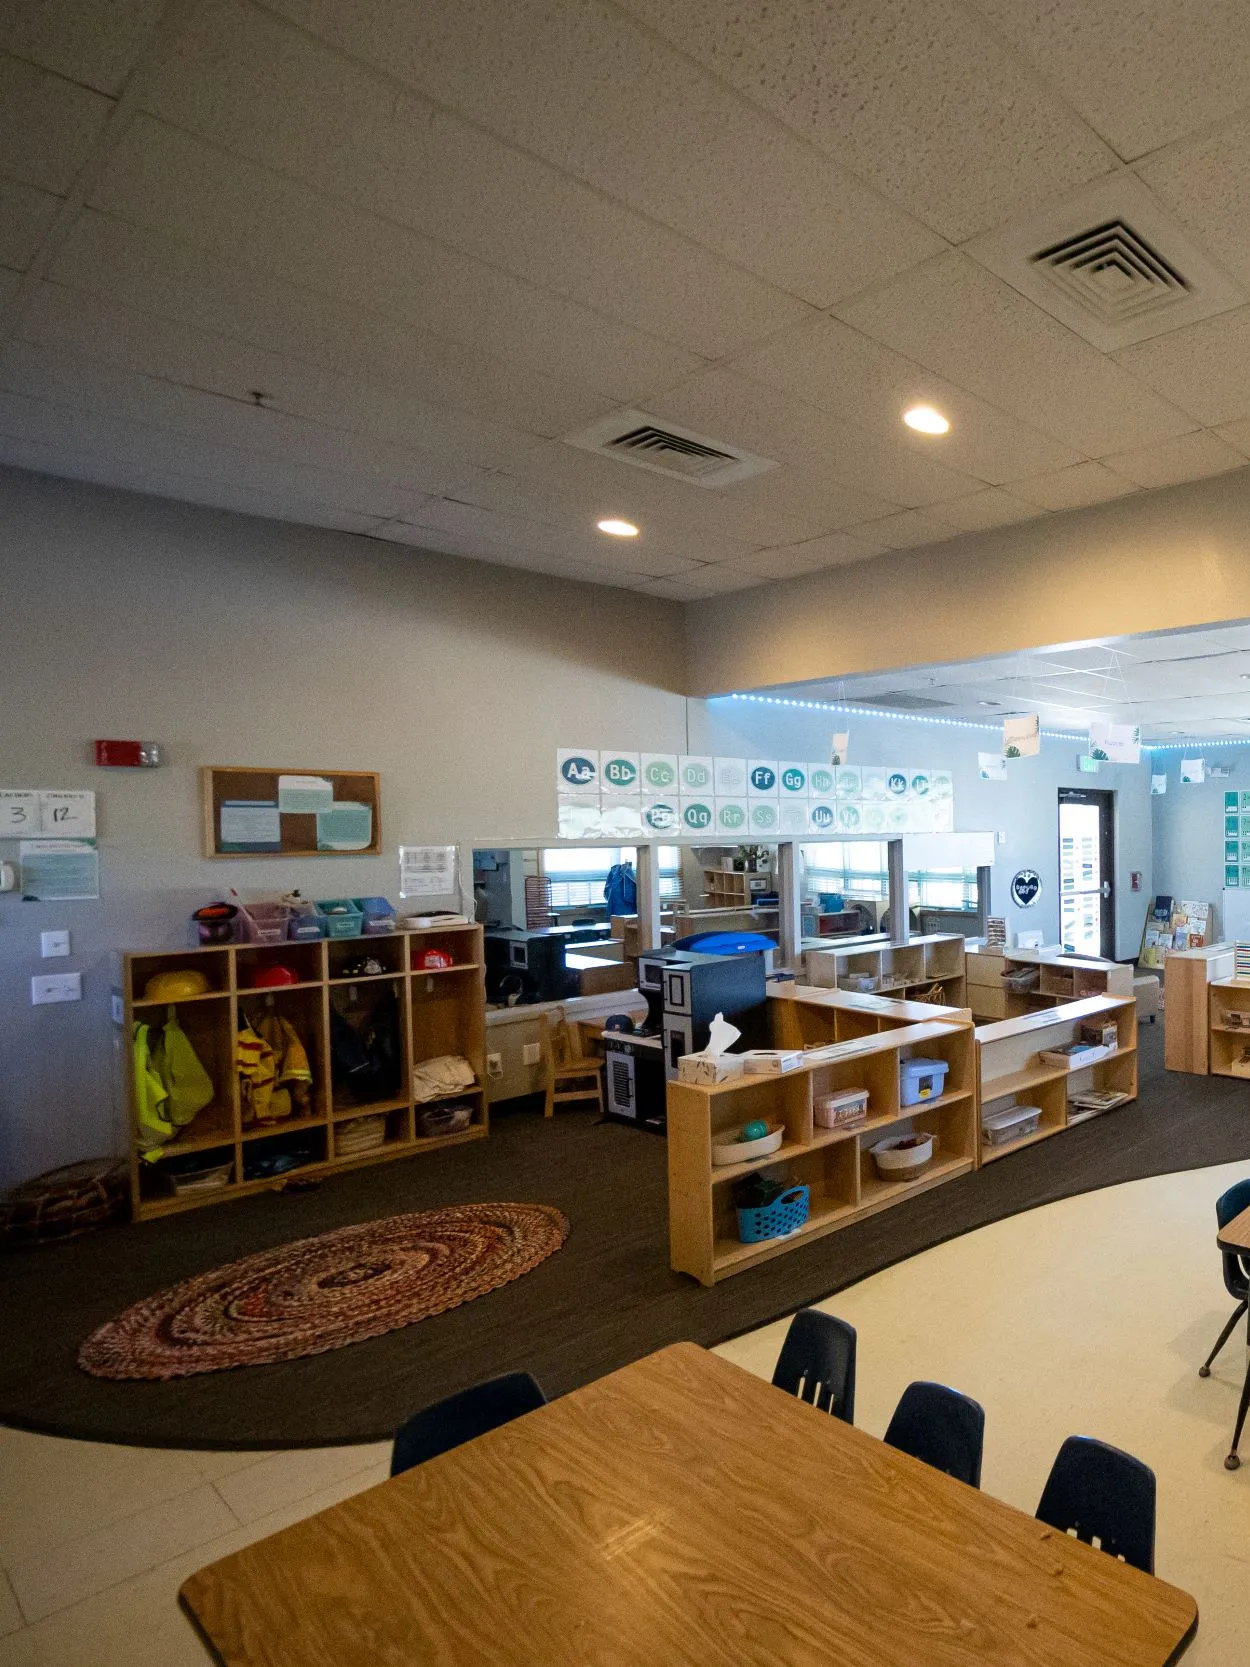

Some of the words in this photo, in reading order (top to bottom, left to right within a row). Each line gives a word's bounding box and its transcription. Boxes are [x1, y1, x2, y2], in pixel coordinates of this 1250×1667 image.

[567, 762, 593, 781] Aa
[609, 764, 631, 781] Bb
[650, 767, 670, 782] Cc
[688, 769, 705, 782] Dd
[755, 772, 771, 785] Ff
[786, 772, 801, 788] Gg
[815, 776, 829, 787] Hh
[891, 778, 905, 791] Kk
[10, 807, 26, 824] 3
[53, 807, 78, 822] 12
[688, 810, 707, 826] Qq
[724, 811, 740, 824] Rr
[757, 811, 771, 824] Ss
[816, 810, 830, 822] Uu
